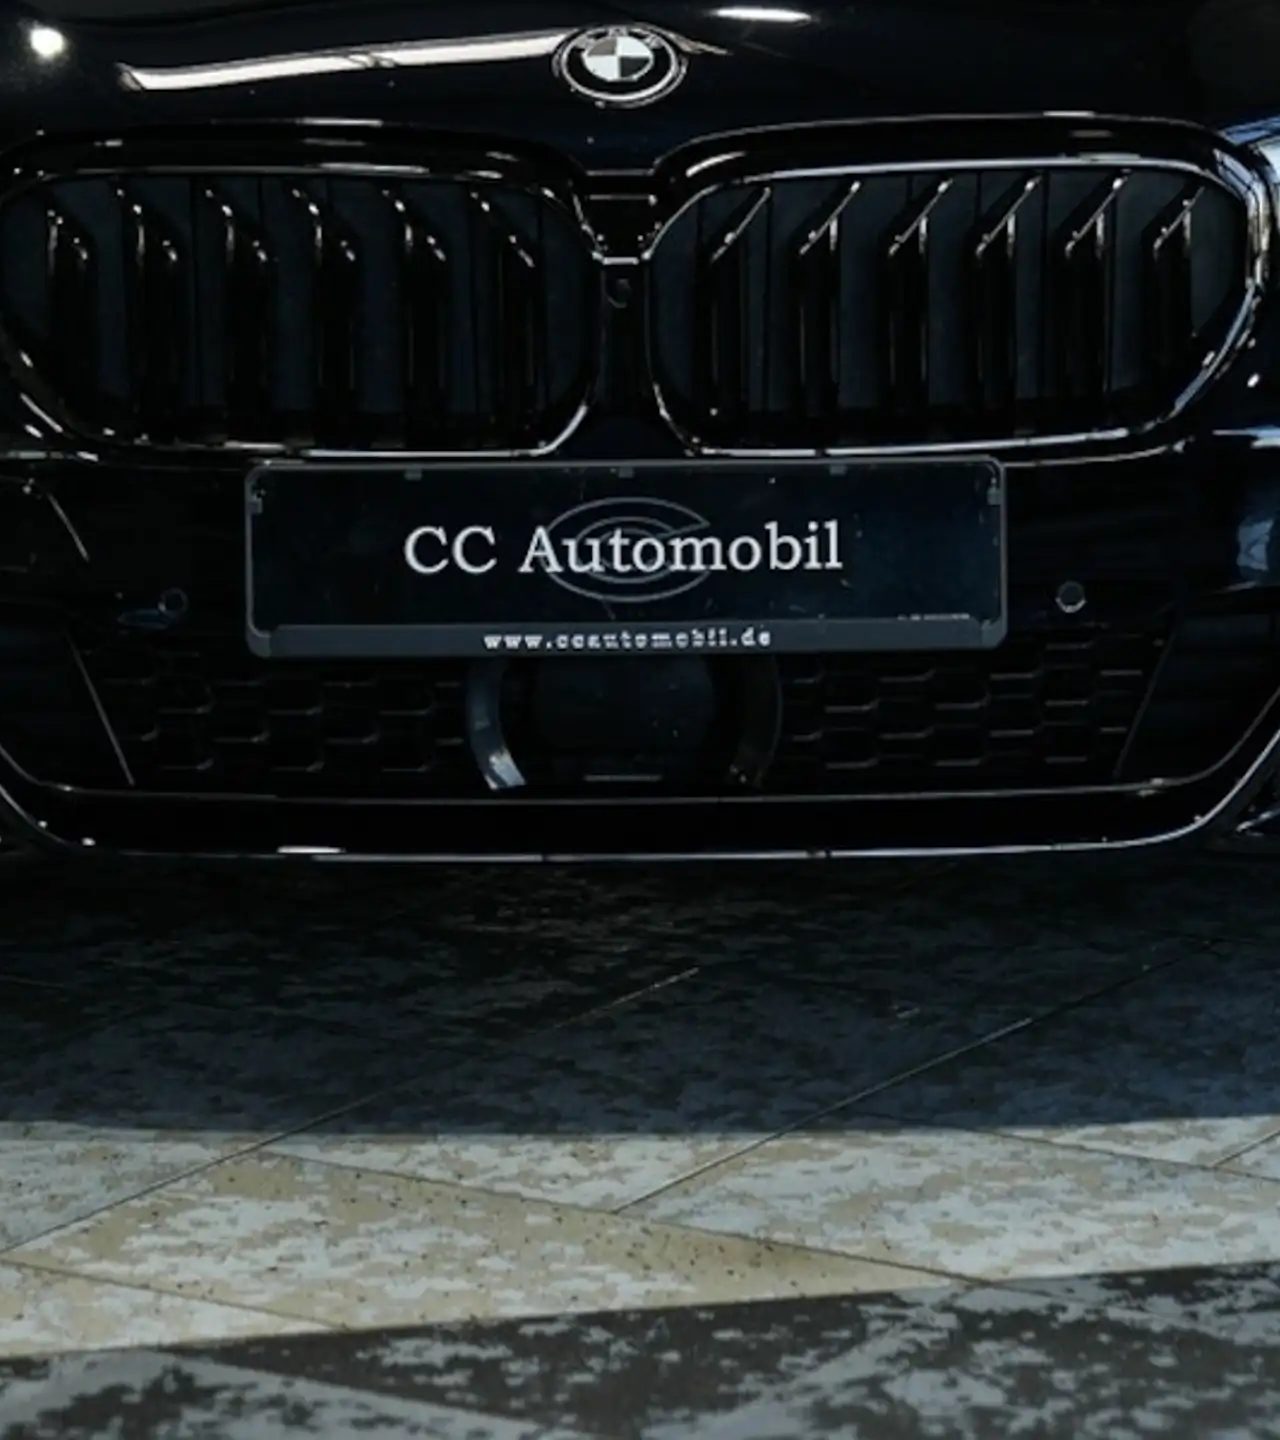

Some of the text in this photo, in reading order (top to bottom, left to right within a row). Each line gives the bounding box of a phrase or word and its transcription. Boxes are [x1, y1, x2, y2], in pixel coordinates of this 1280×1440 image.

[404, 519, 844, 574] CC Automobil
[483, 627, 771, 650] www.ccautomobil.de
